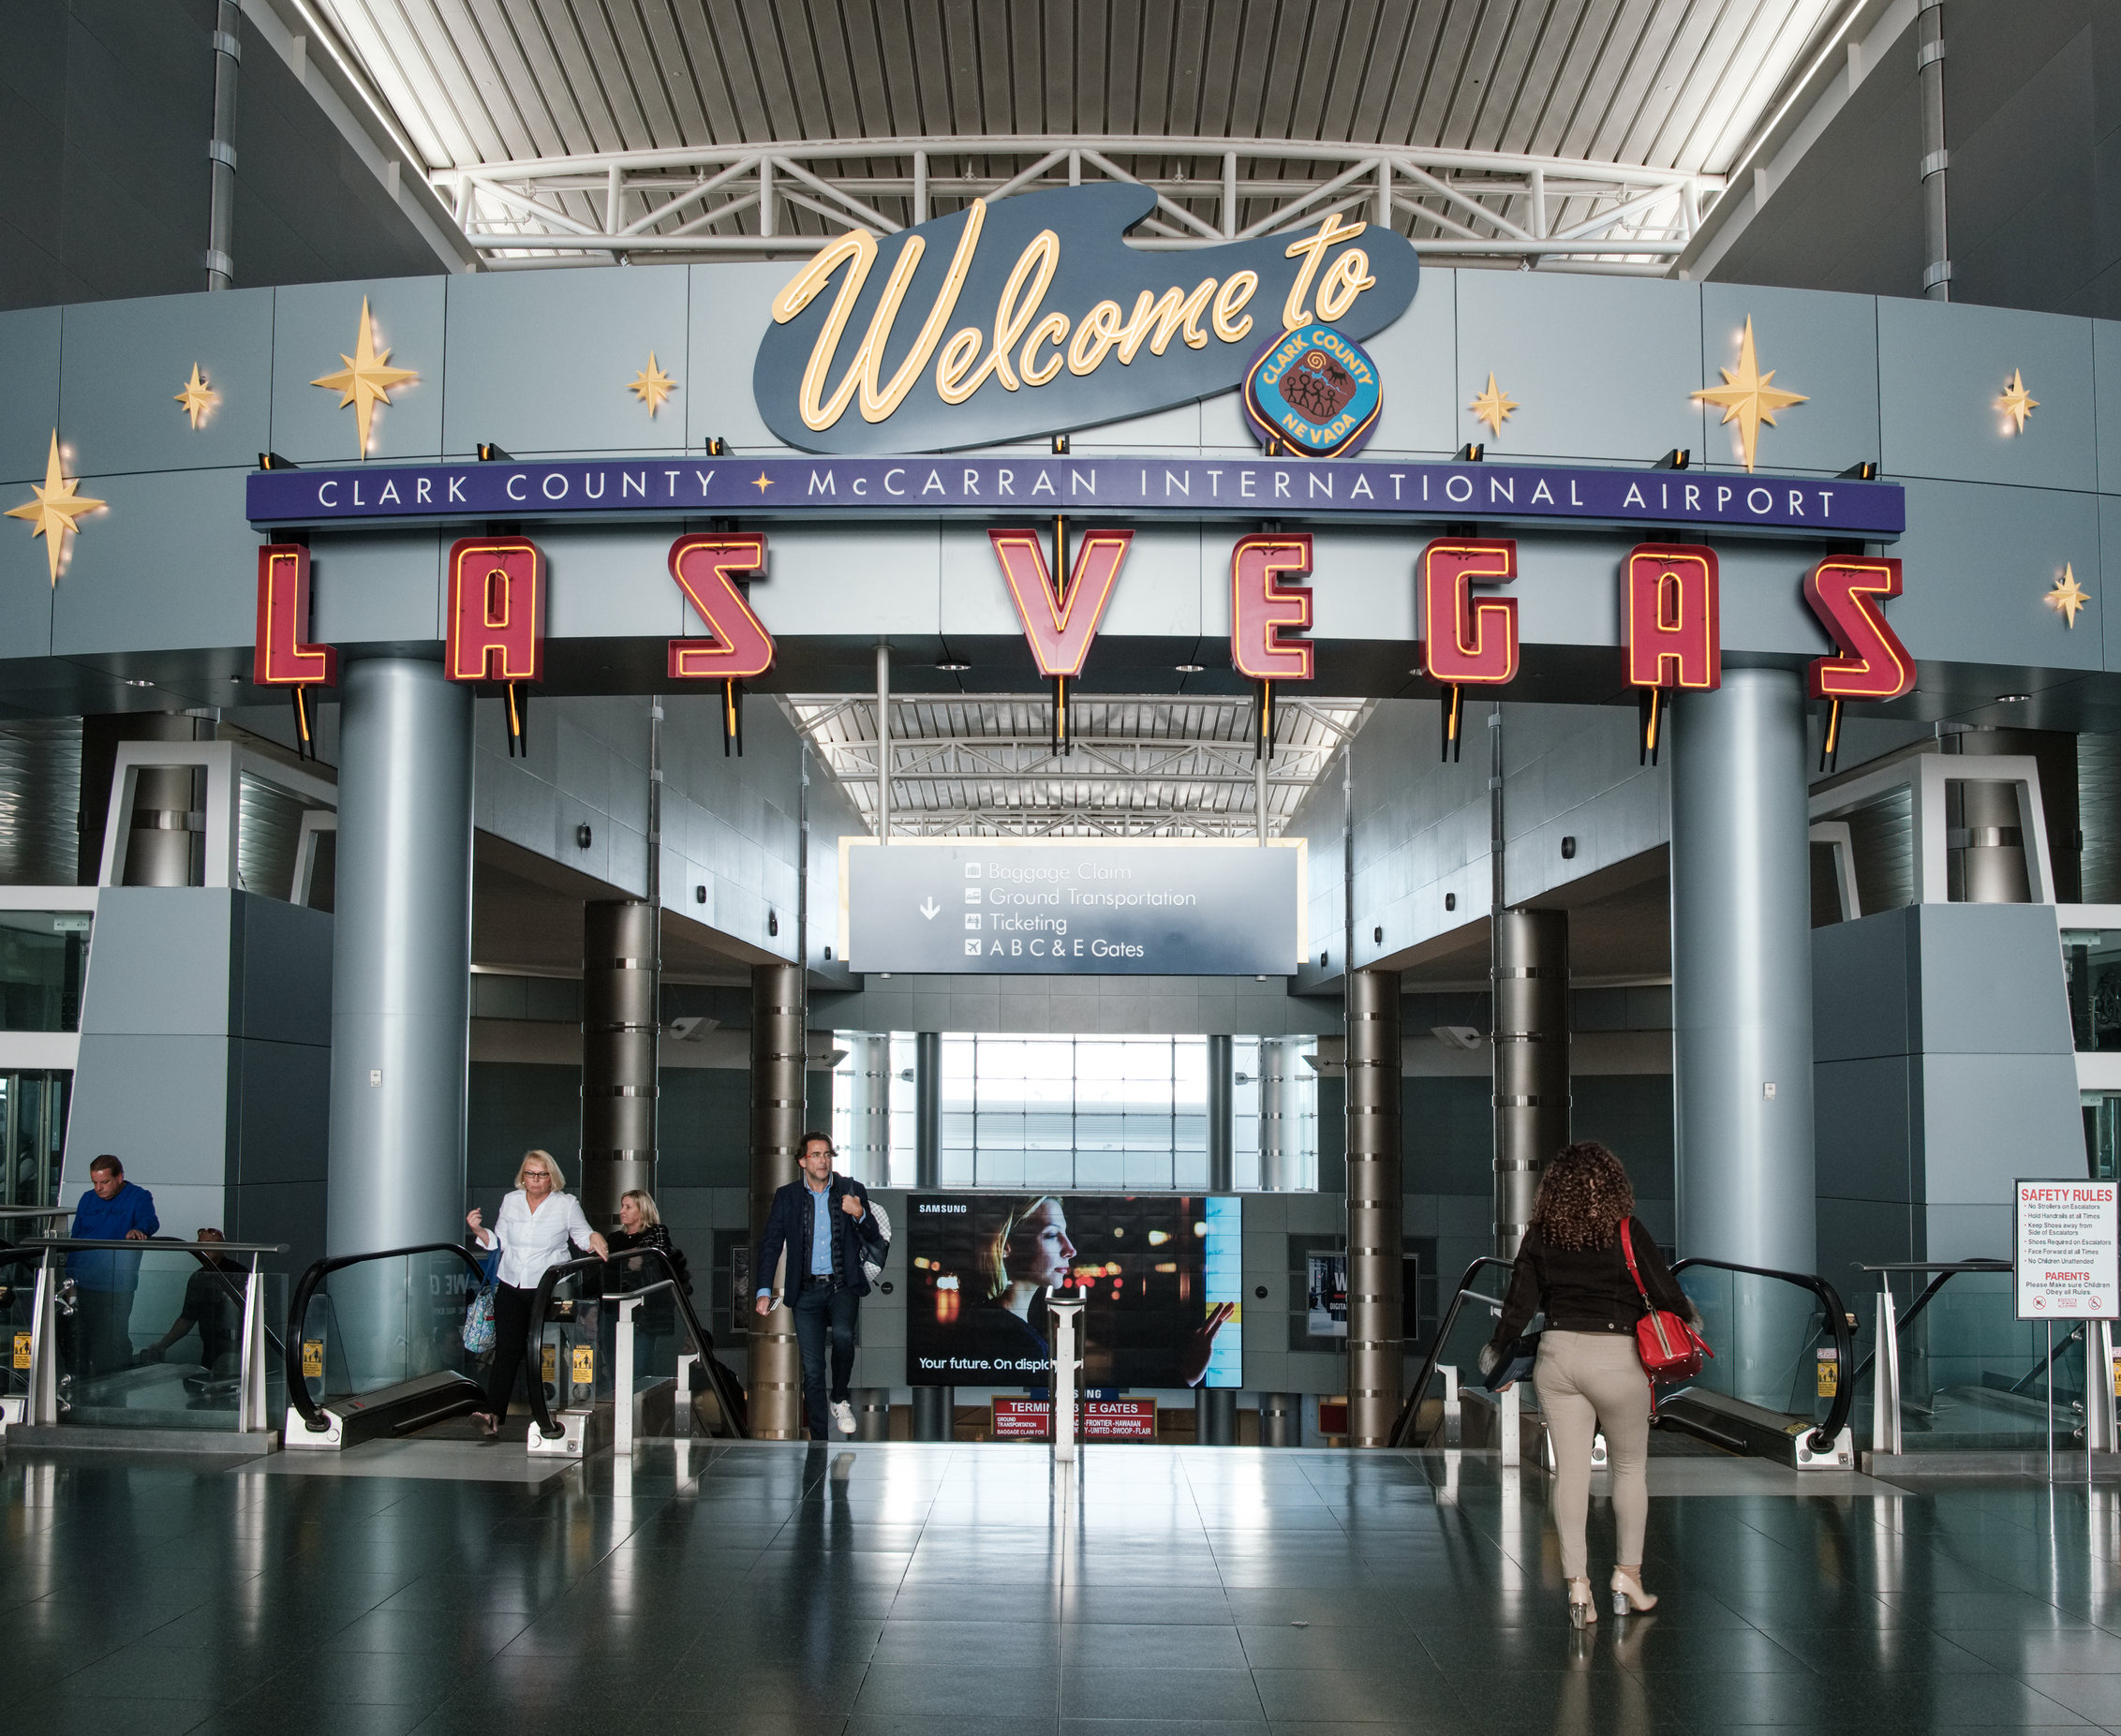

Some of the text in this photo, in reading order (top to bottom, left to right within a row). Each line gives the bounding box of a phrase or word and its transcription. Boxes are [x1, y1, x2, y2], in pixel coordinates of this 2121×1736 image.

[772, 198, 1375, 432] Welcome to
[1263, 330, 1373, 385] CLARK COUNTY
[1282, 413, 1357, 444] NEVADA
[318, 468, 1834, 518] CLARK COUNTY McCARRAN INTERNATIONAL AIRPORT
[254, 529, 1917, 703] LAS VEGAS
[989, 862, 1132, 883] Baggage Claim
[989, 887, 1196, 910] Ground Transportation
[989, 913, 1068, 935] Ticketing
[989, 939, 1144, 957] A B C & E Gates
[2021, 1188, 2113, 1202] SAFETY RULES
[919, 1204, 967, 1213] SAMSUNG
[2045, 1271, 2090, 1281] PARENTS
[1329, 1302, 1348, 1311] DIGITA
[919, 1358, 947, 1370] Your
[950, 1357, 991, 1370] future.
[994, 1358, 1013, 1370] On
[1089, 1403, 1097, 1413] E
[1100, 1403, 1139, 1414] GATES
